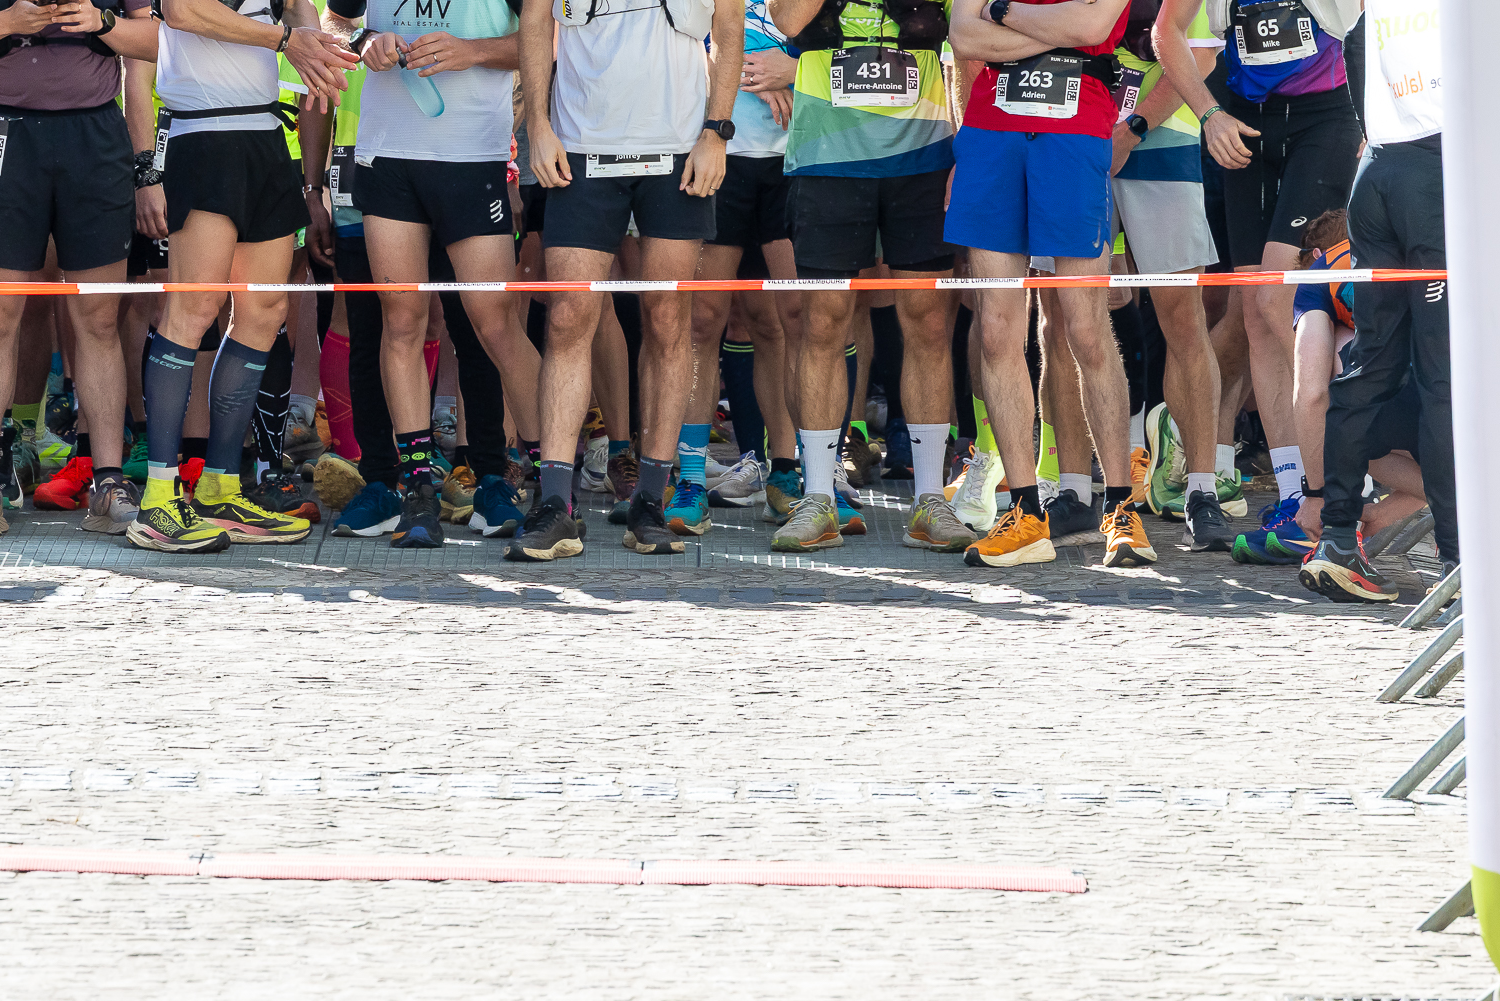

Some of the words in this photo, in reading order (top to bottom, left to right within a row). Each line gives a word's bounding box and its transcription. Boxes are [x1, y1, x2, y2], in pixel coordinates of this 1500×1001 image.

[416, 20, 451, 29] ESTATE
[1257, 18, 1280, 37] 65
[1262, 39, 1281, 48] Mike
[856, 62, 891, 79] 431
[1018, 70, 1054, 88] 263
[847, 82, 903, 90] Pierre-Antoine
[1021, 90, 1046, 100] Adrien
[159, 359, 183, 371] cep
[150, 508, 181, 537] HOKA
